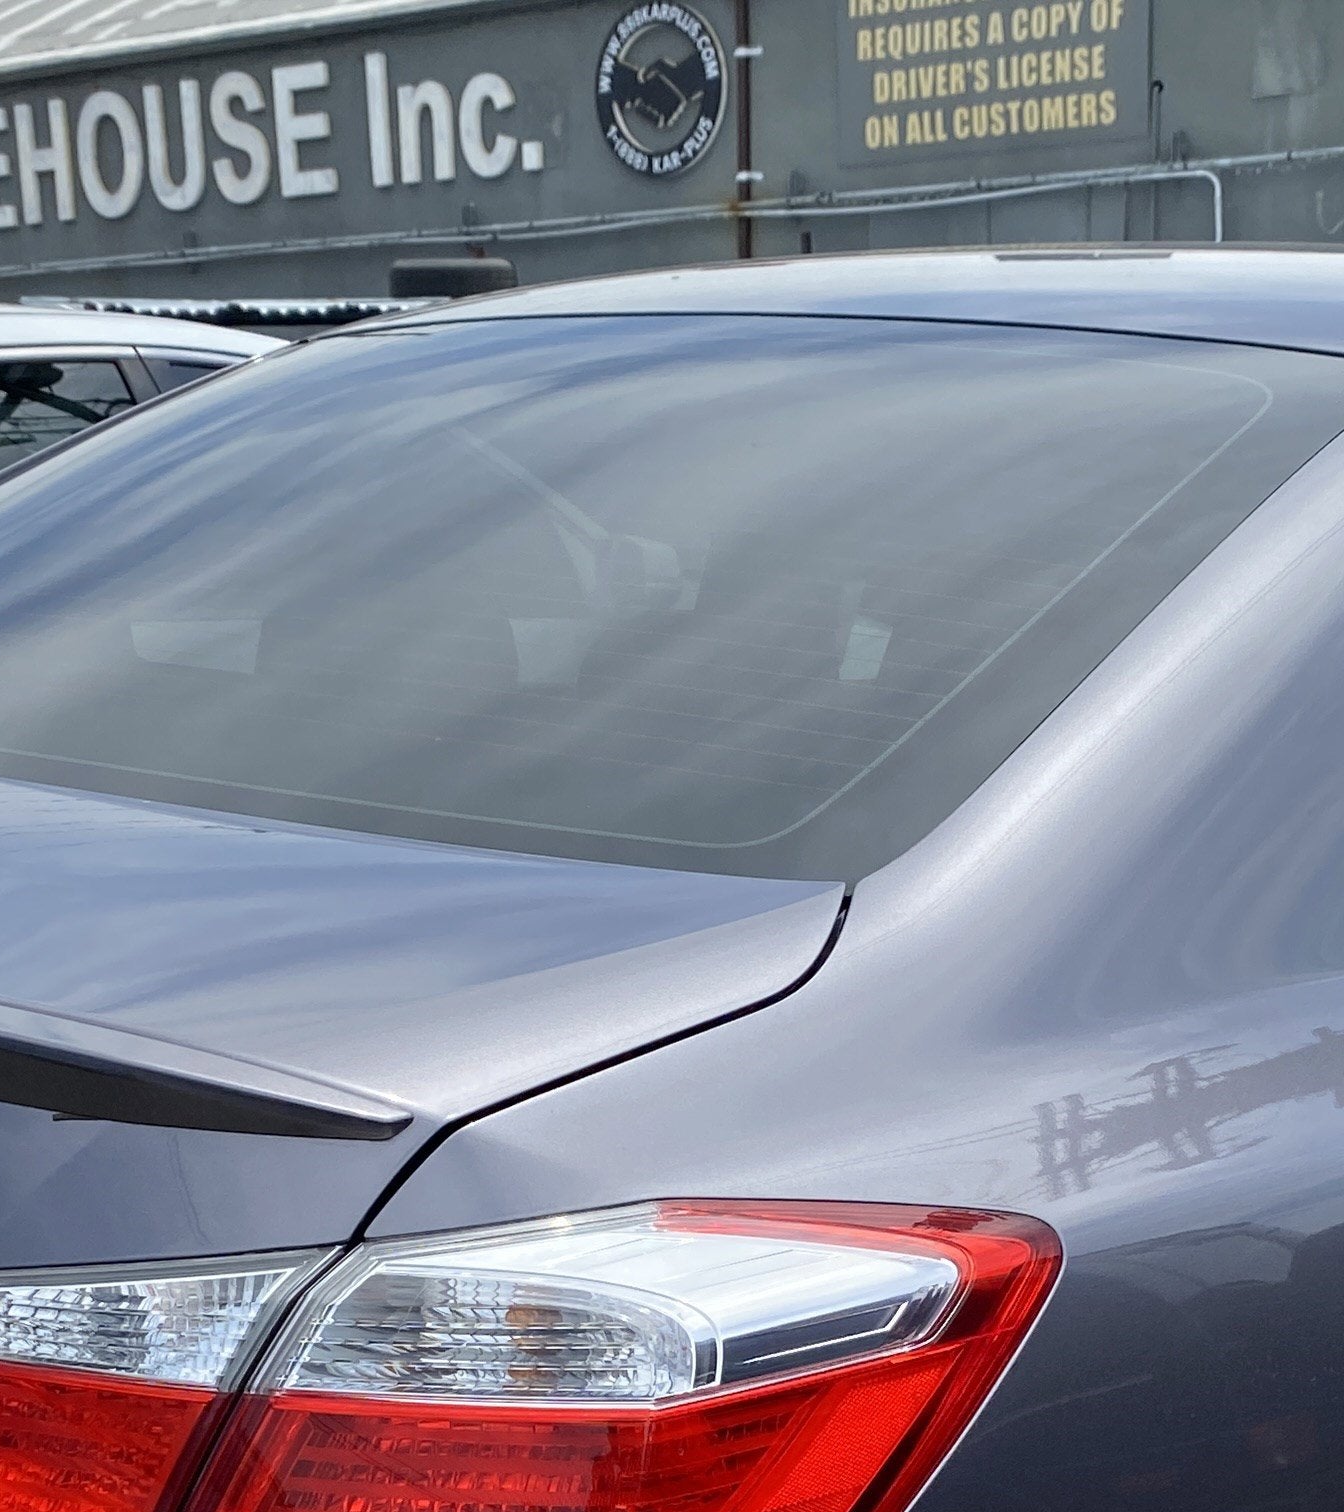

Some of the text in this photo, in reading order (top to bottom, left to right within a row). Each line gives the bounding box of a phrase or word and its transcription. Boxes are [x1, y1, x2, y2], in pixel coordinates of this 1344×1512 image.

[857, 14, 981, 62] REQUIRES
[986, 11, 1005, 47] A
[1010, 1, 1084, 43] COPY
[1089, 0, 1125, 33] OF
[873, 44, 1106, 104] DRIVER'S LICENSE
[363, 51, 546, 188] Inc.
[864, 89, 1117, 150] ON ALL CUSTOMERS
